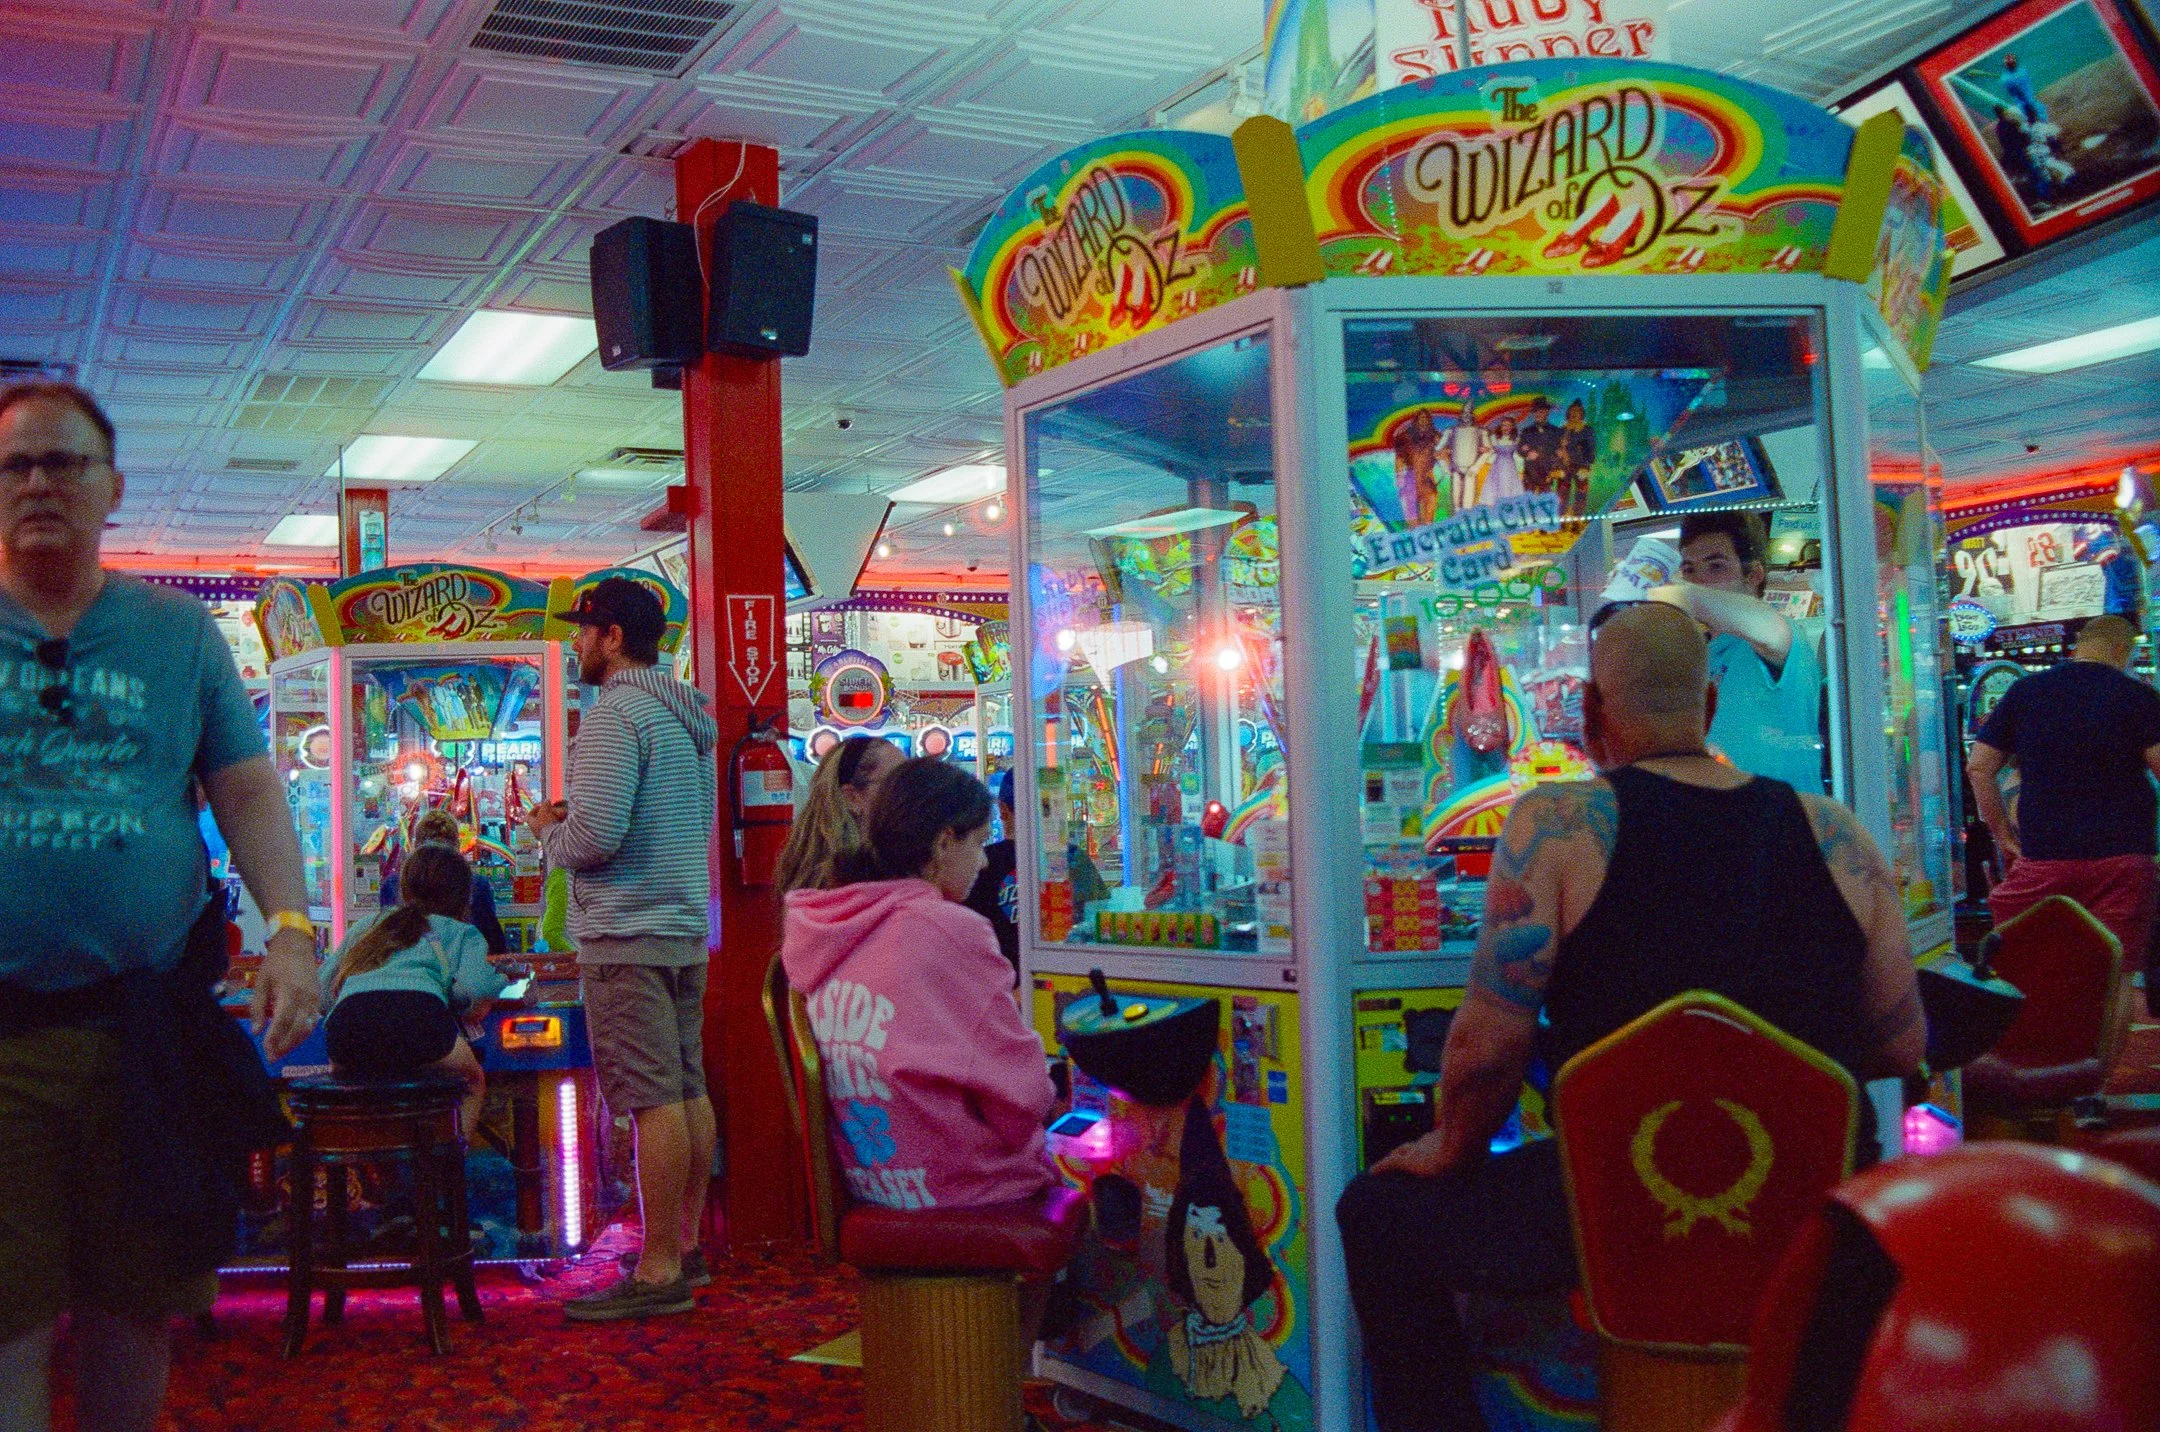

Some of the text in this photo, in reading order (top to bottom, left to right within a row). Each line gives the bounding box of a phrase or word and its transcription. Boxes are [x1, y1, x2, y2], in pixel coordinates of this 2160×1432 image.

[1491, 86, 1539, 123] The
[1415, 86, 1656, 228] WIZARD
[1547, 190, 1578, 221] of
[1020, 165, 1128, 321] WIZARD
[1370, 496, 1558, 566] Emerald City
[399, 572, 419, 588] The
[1442, 543, 1512, 585] Card
[371, 572, 468, 626] WIZARD
[744, 600, 757, 640] FIRE
